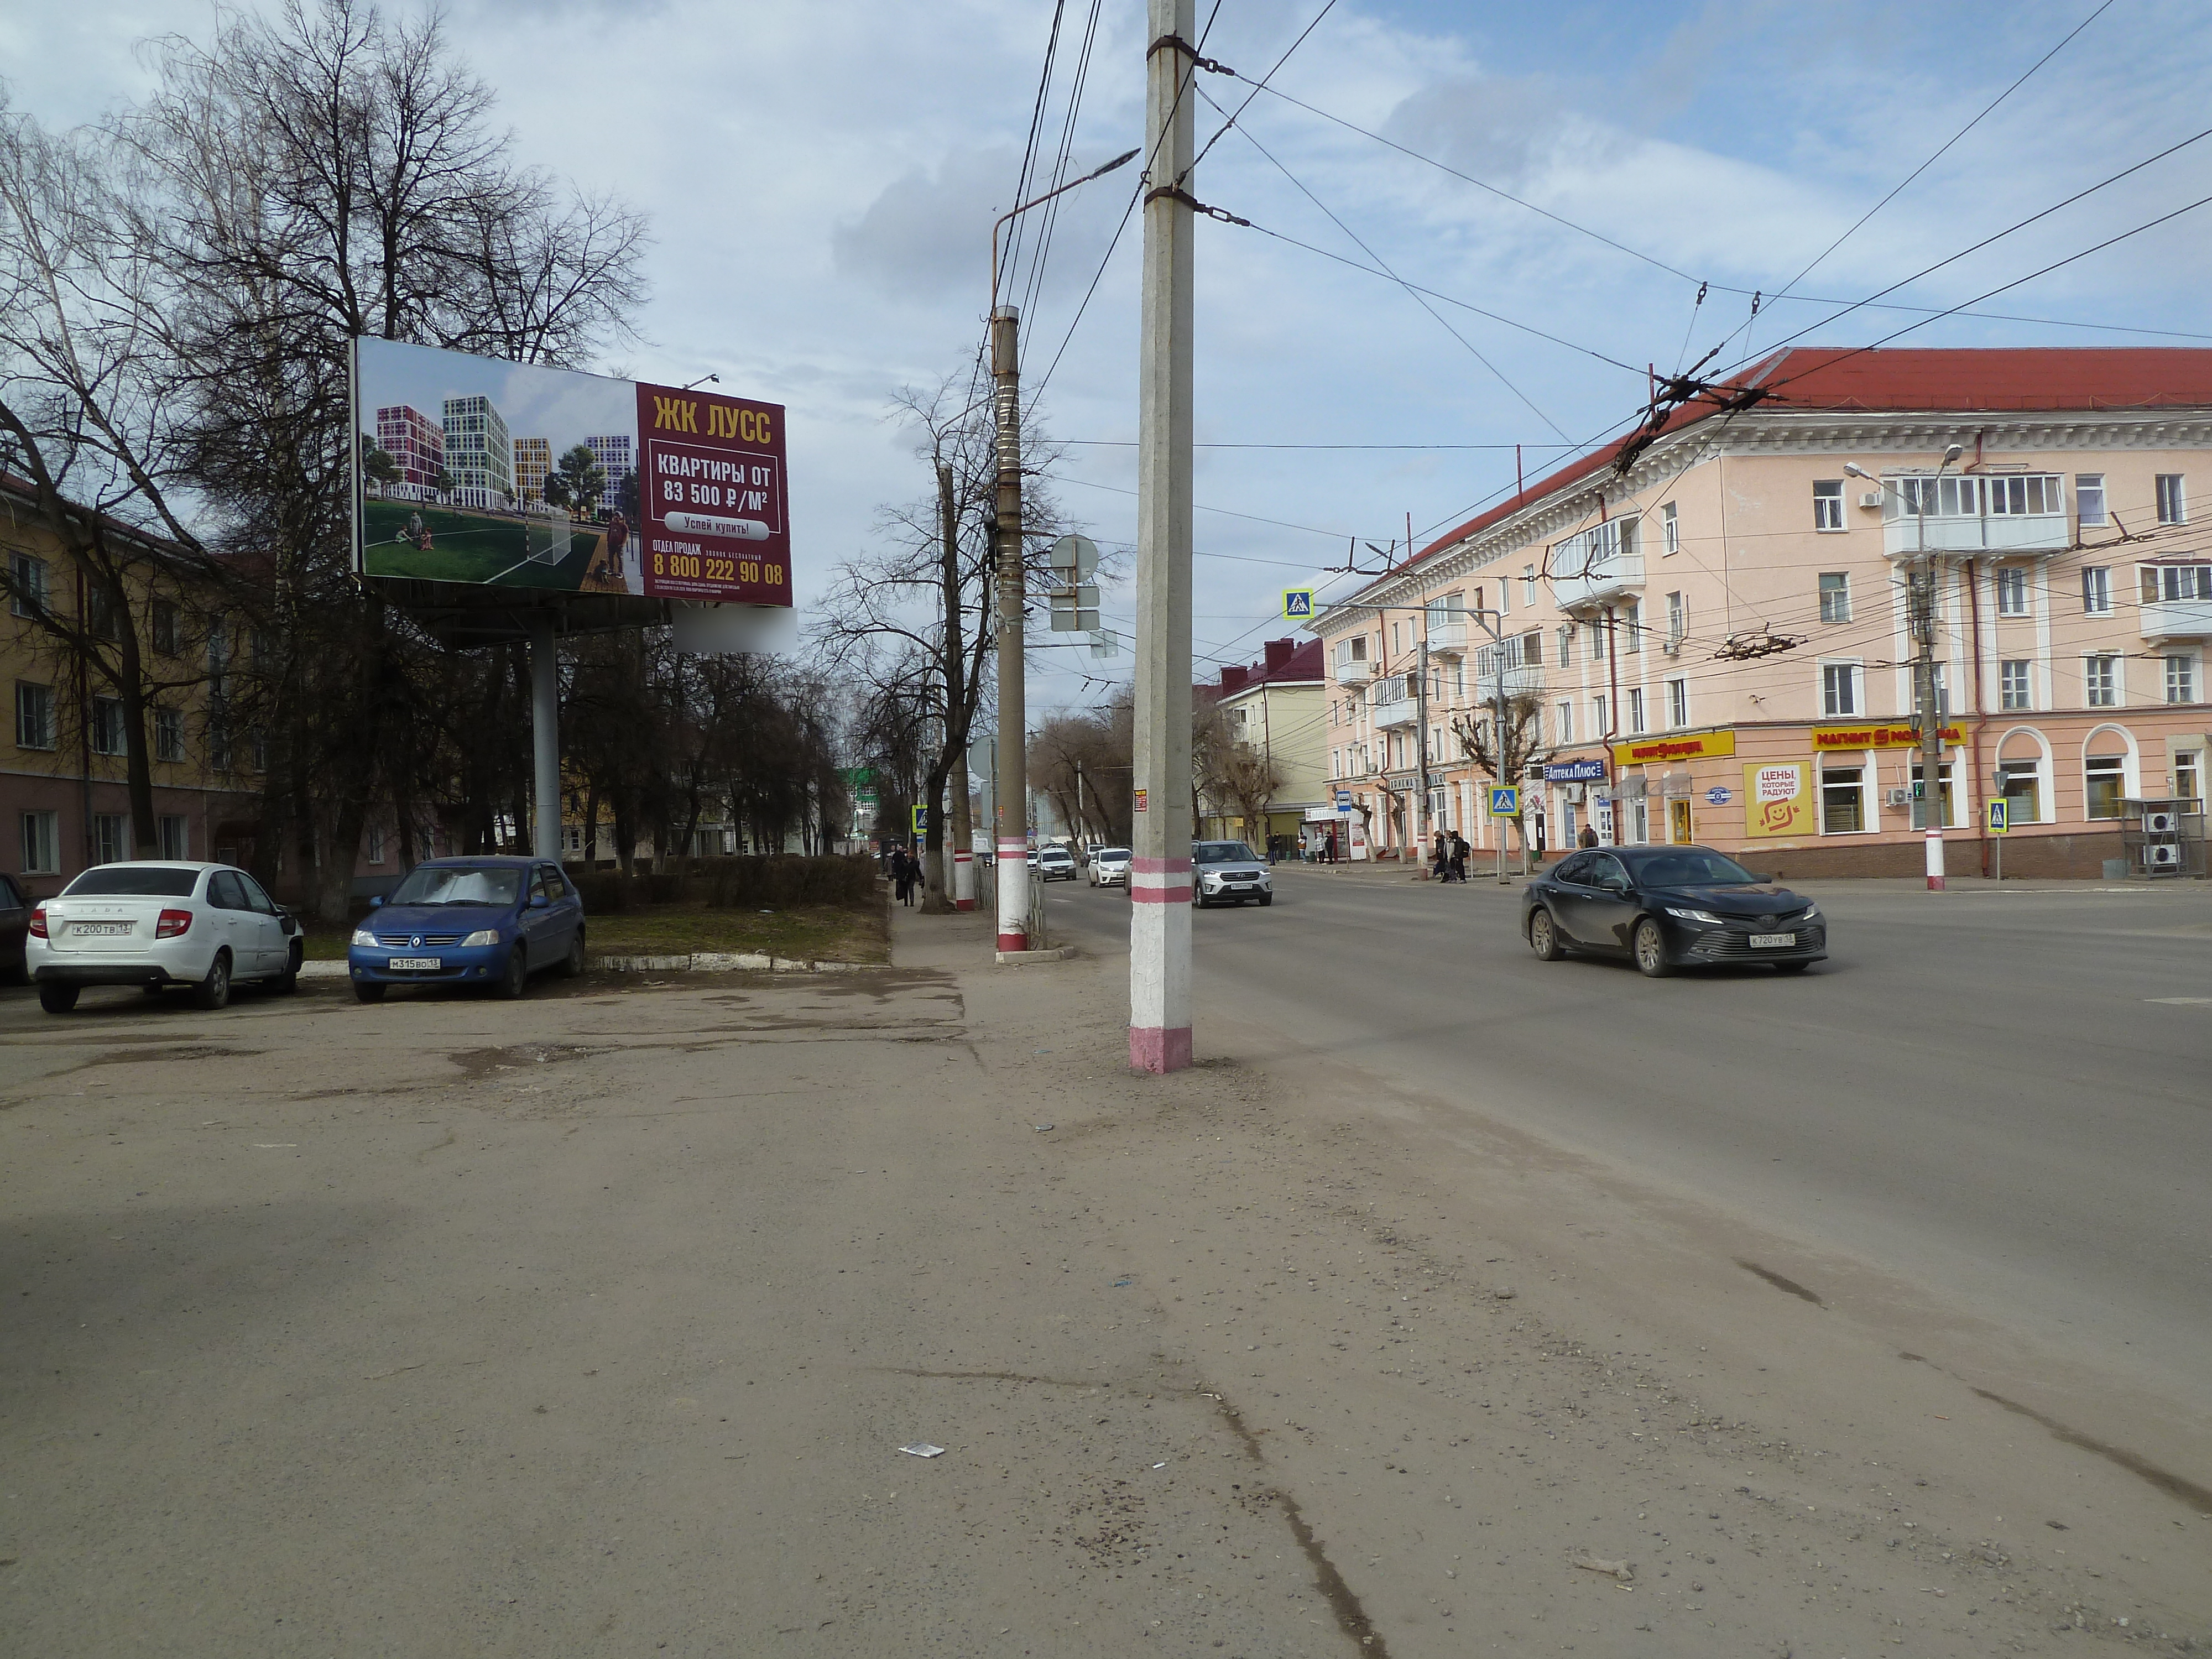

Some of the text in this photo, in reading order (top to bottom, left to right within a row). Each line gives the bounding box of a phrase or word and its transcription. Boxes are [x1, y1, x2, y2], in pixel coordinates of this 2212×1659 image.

[653, 395, 771, 444] ЖК ЛУСС
[658, 453, 771, 487] КВАРТИРЫ ОТ
[664, 480, 684, 502] 83
[691, 483, 720, 507] 500
[684, 516, 749, 535] Успей купить!
[653, 539, 702, 555] ОТДЕЛ ПРОДАЖ
[654, 553, 664, 575] 8
[670, 555, 700, 578] 800
[706, 558, 734, 581] 222
[739, 561, 759, 583] 90
[764, 564, 784, 585] 08
[1816, 732, 1872, 745] МАГНИТ
[1762, 788, 1796, 796] РАДУЮТ
